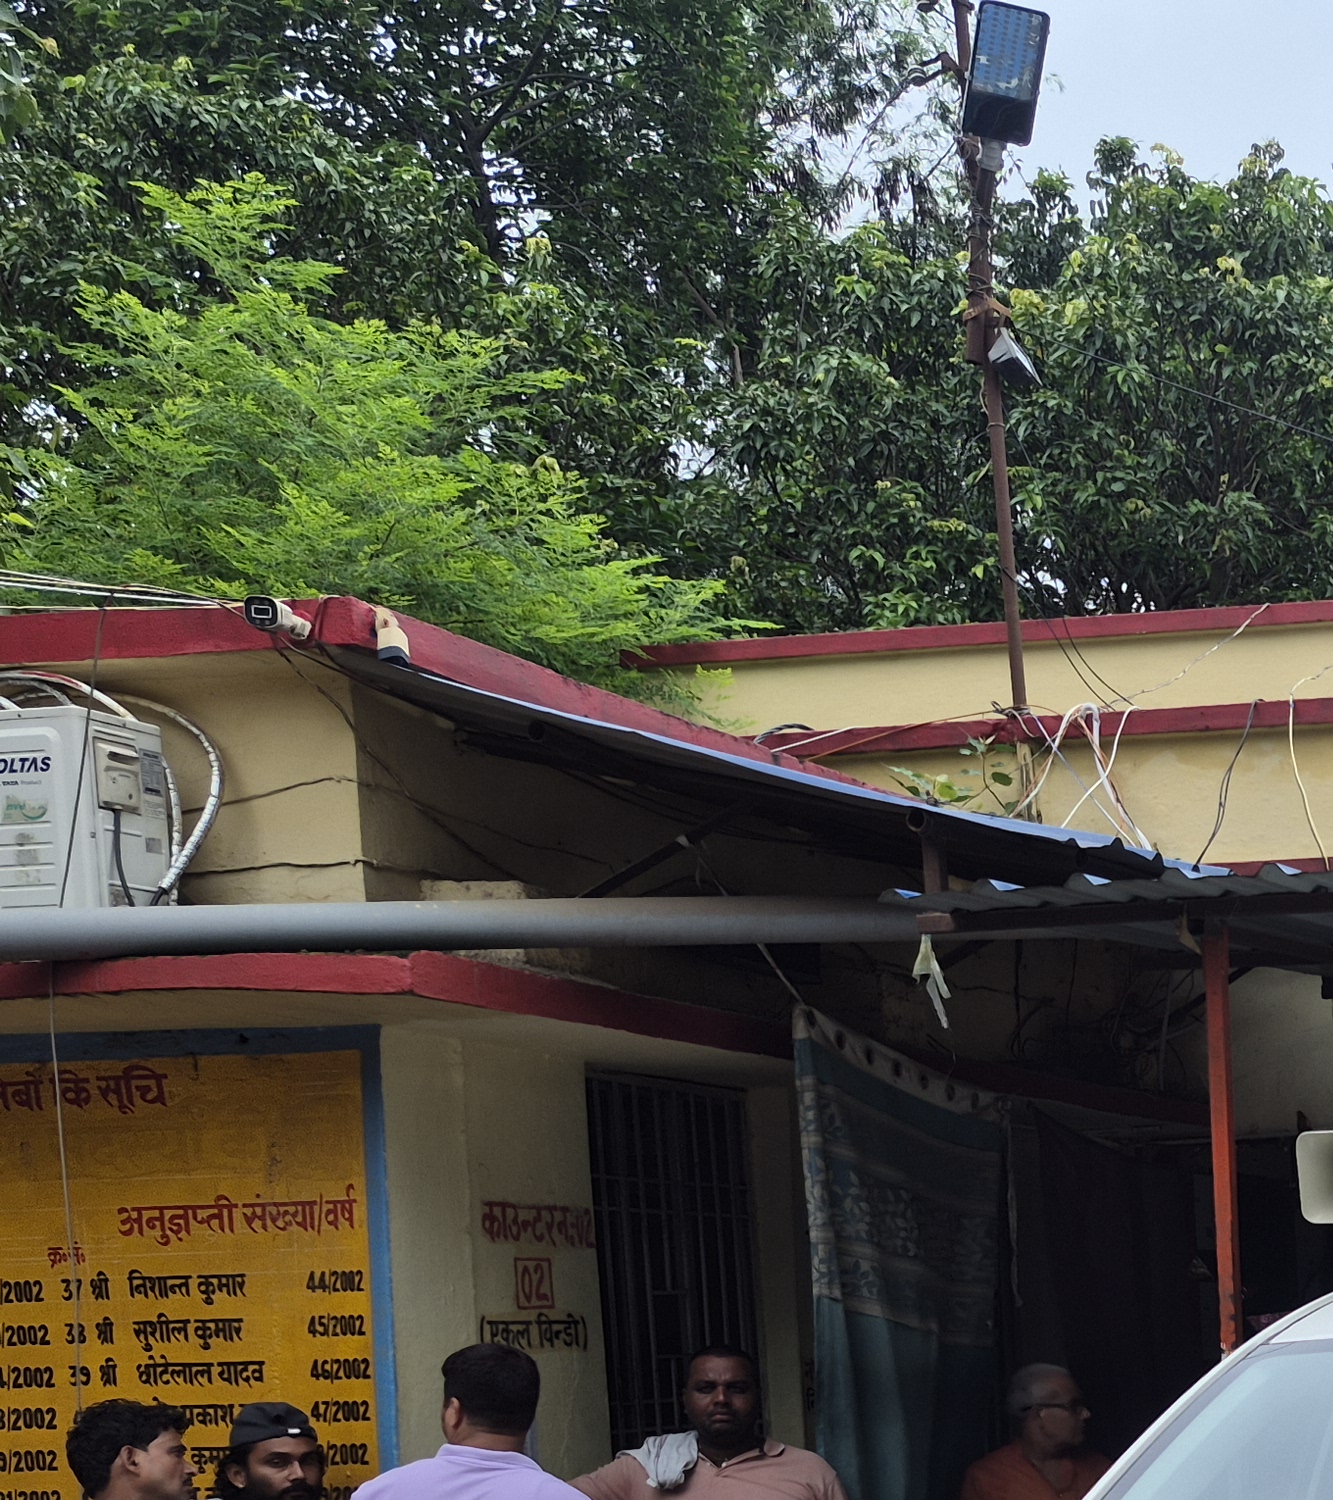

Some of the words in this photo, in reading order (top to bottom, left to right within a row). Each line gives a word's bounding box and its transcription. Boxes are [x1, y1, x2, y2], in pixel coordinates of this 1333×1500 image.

[61, 1278, 83, 1302] 37
[90, 1270, 110, 1301] श्री
[127, 1269, 193, 1301] निशान्त
[197, 1273, 247, 1306] कुमार
[520, 1263, 550, 1304] 02
[95, 1316, 114, 1346] श्री
[132, 1312, 191, 1353] सुशील
[194, 1318, 243, 1351] कुमार
[99, 1357, 117, 1388] श्री
[217, 1360, 266, 1389] यादव
